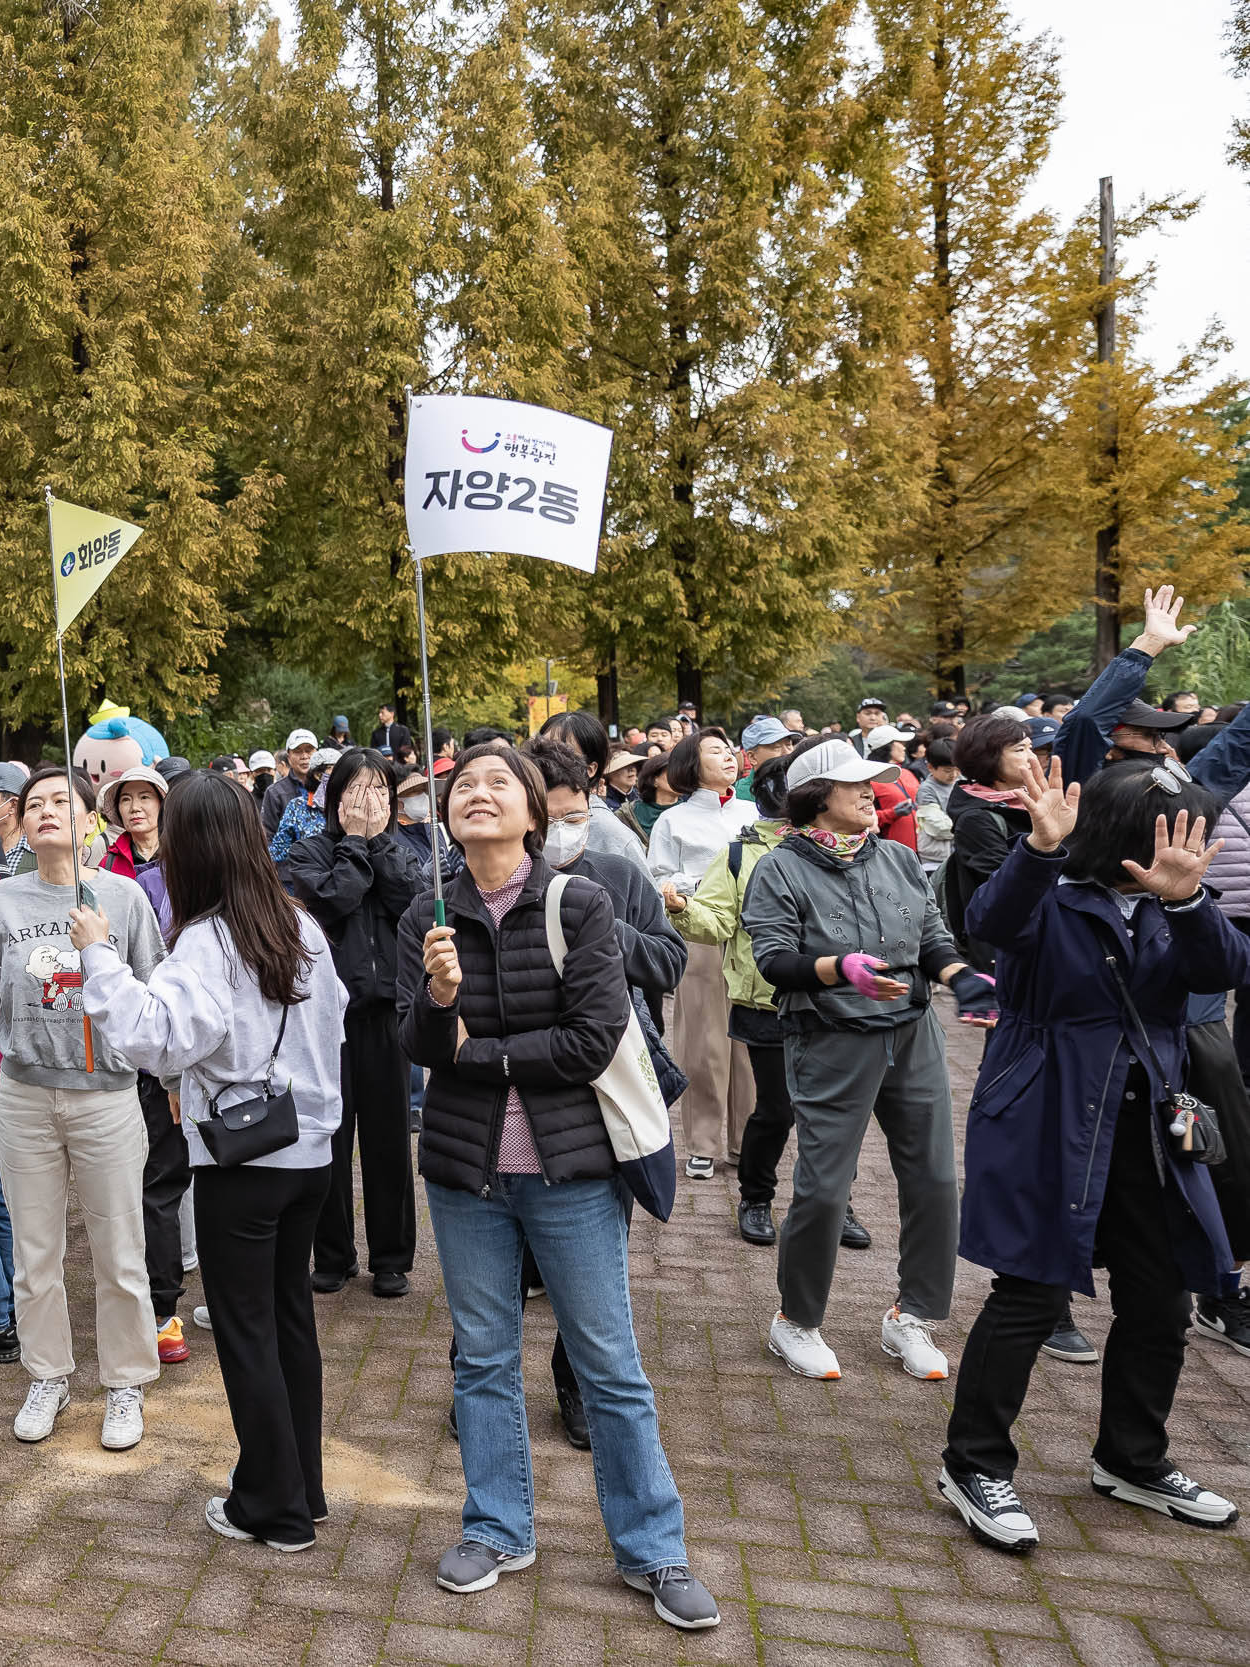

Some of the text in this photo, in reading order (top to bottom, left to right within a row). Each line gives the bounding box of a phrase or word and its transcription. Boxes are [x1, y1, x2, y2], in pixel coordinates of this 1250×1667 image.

[504, 443, 556, 466] 행복광진
[422, 469, 580, 525] 자양2동
[77, 528, 122, 571] 화양동
